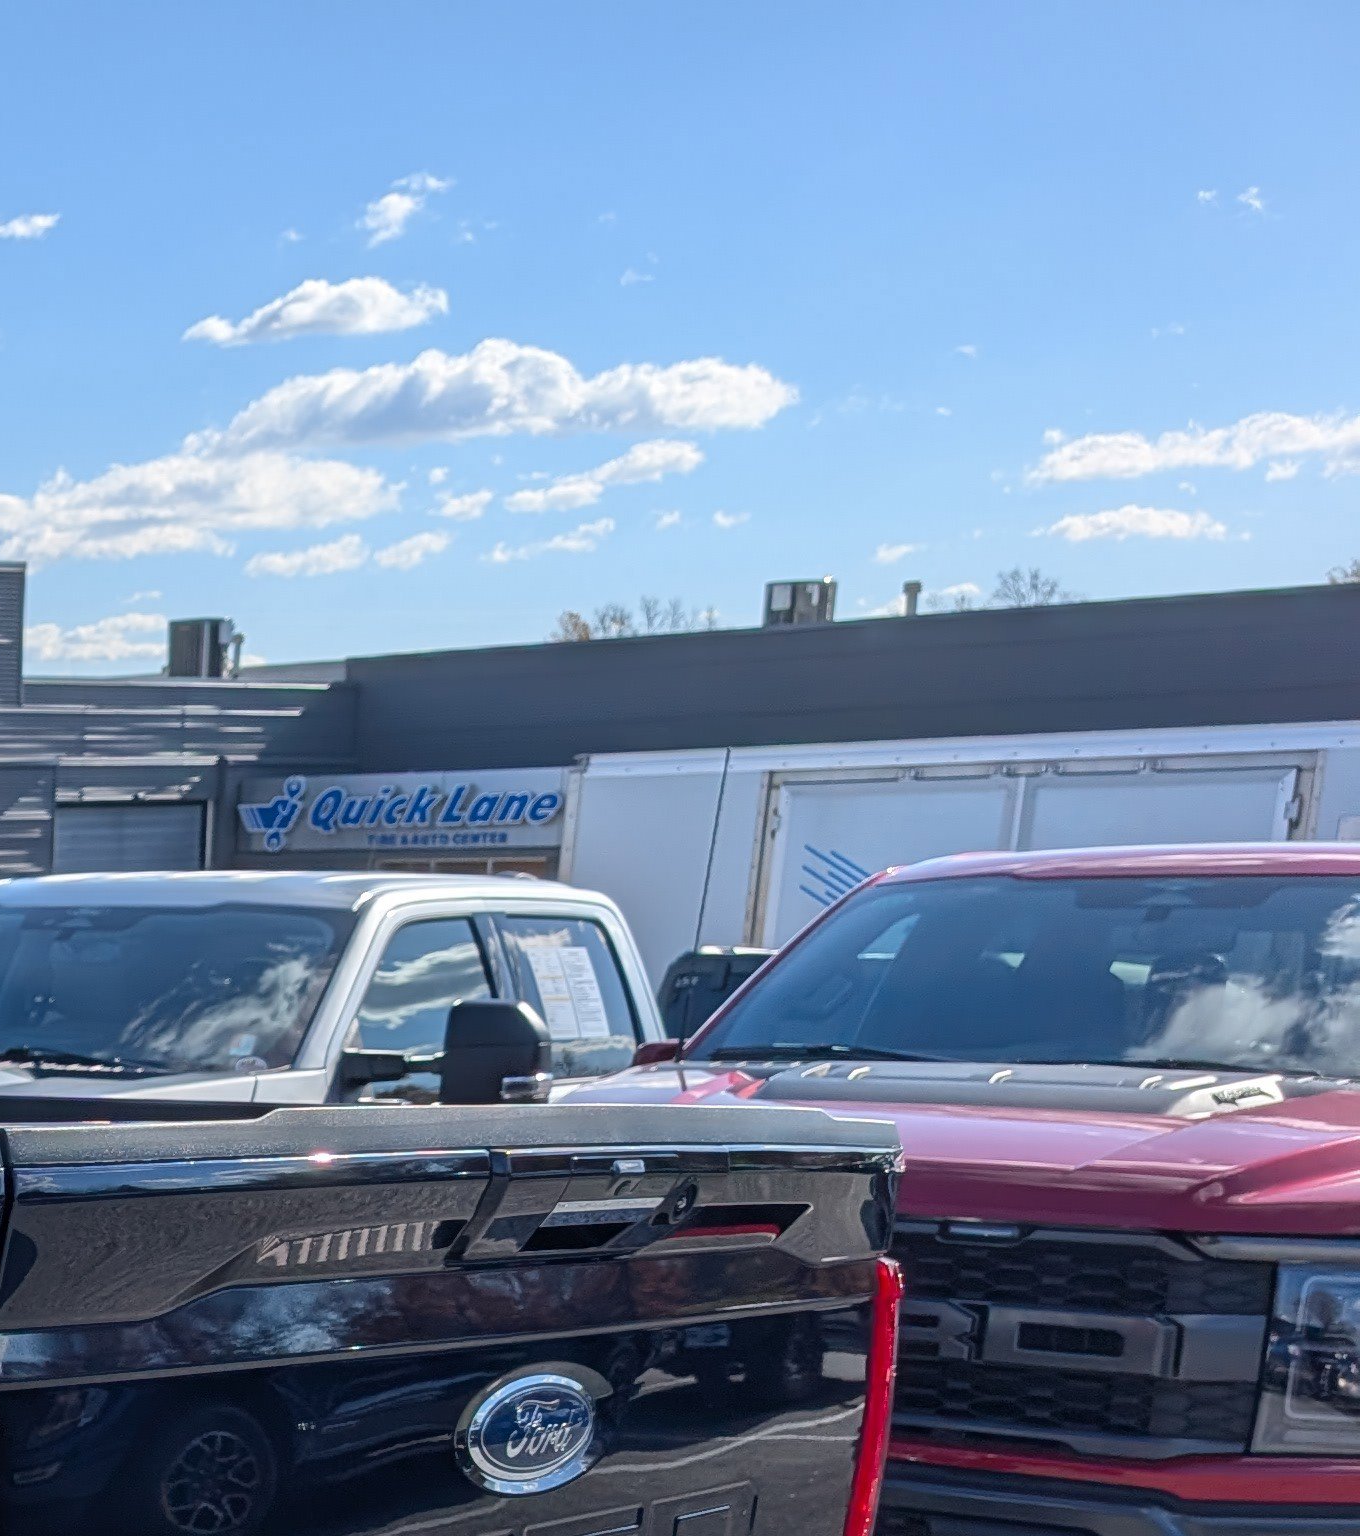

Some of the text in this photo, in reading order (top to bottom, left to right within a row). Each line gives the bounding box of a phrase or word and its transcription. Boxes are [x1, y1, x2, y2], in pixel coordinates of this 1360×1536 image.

[309, 783, 563, 834] Quick Lane
[506, 1397, 579, 1459] Ford
